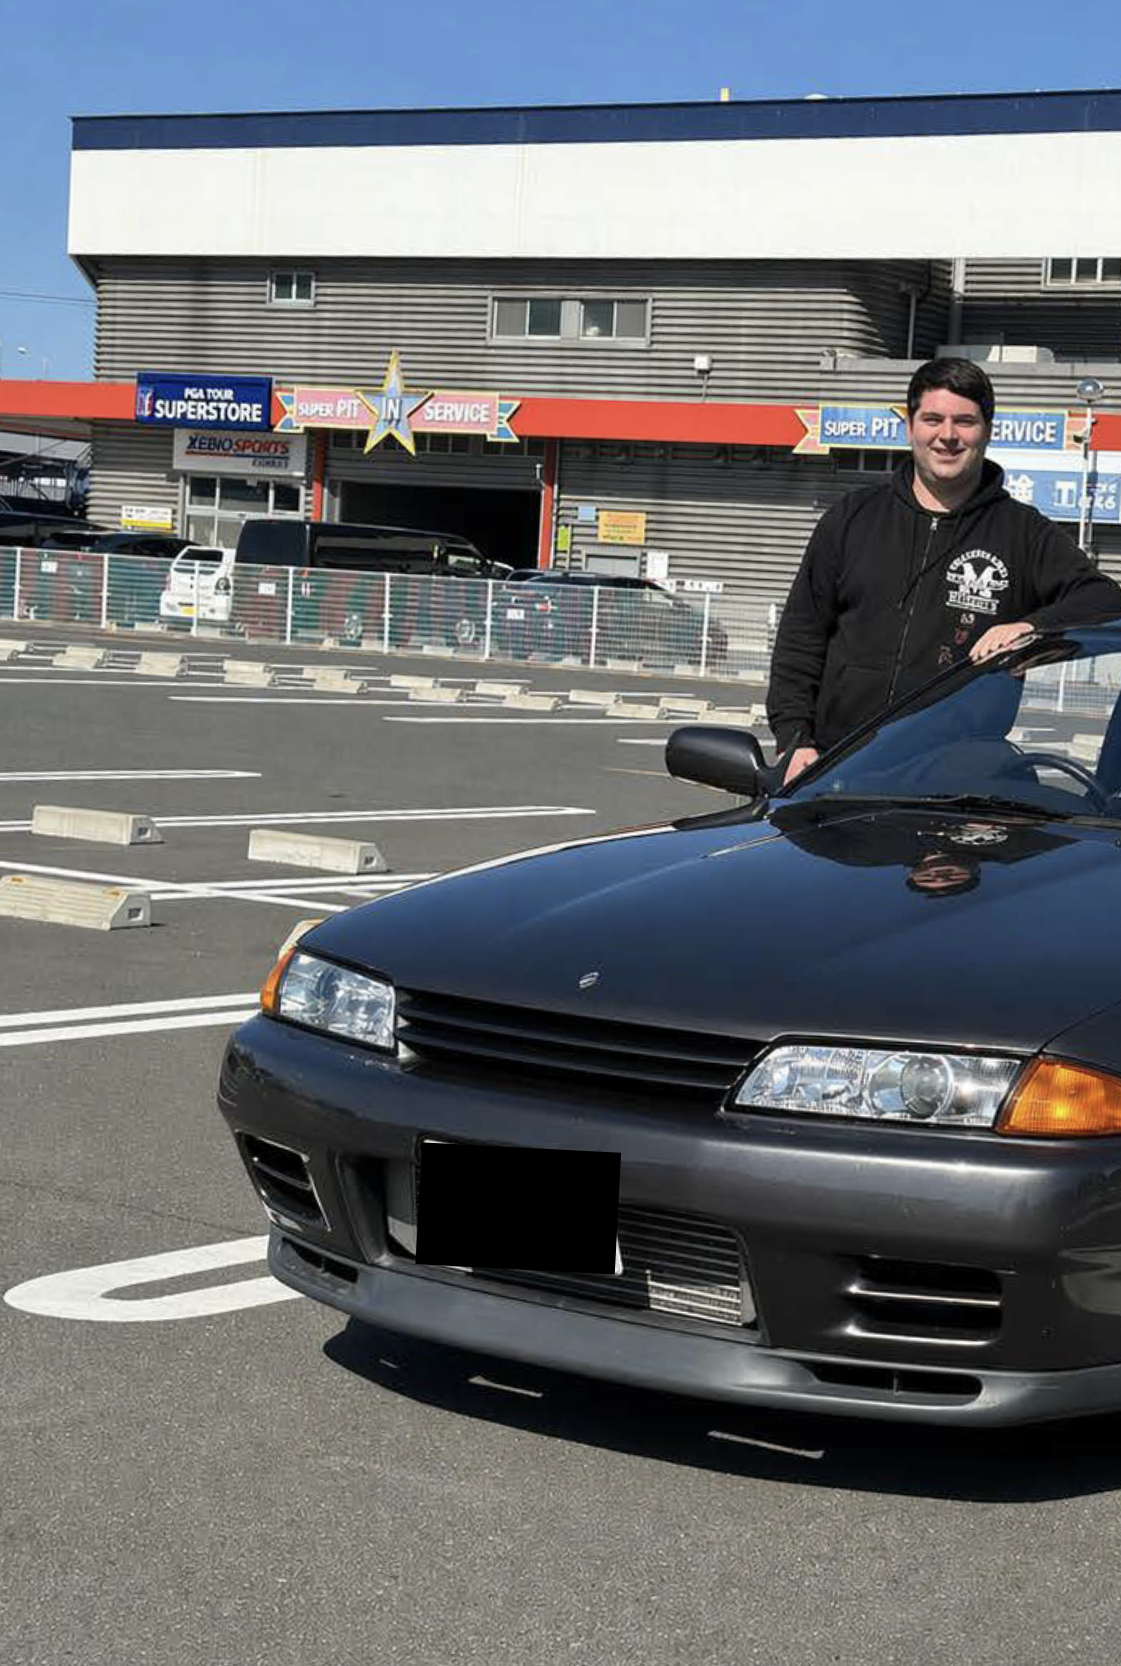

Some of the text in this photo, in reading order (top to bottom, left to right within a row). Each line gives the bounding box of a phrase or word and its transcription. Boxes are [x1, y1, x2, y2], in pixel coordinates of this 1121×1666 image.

[184, 387, 235, 401] PGA TOUR
[154, 399, 262, 422] SUPERSTORE
[298, 397, 490, 422] SUPER PIT IN SERVICE
[824, 416, 1057, 443] SUPER PIT ERVICE
